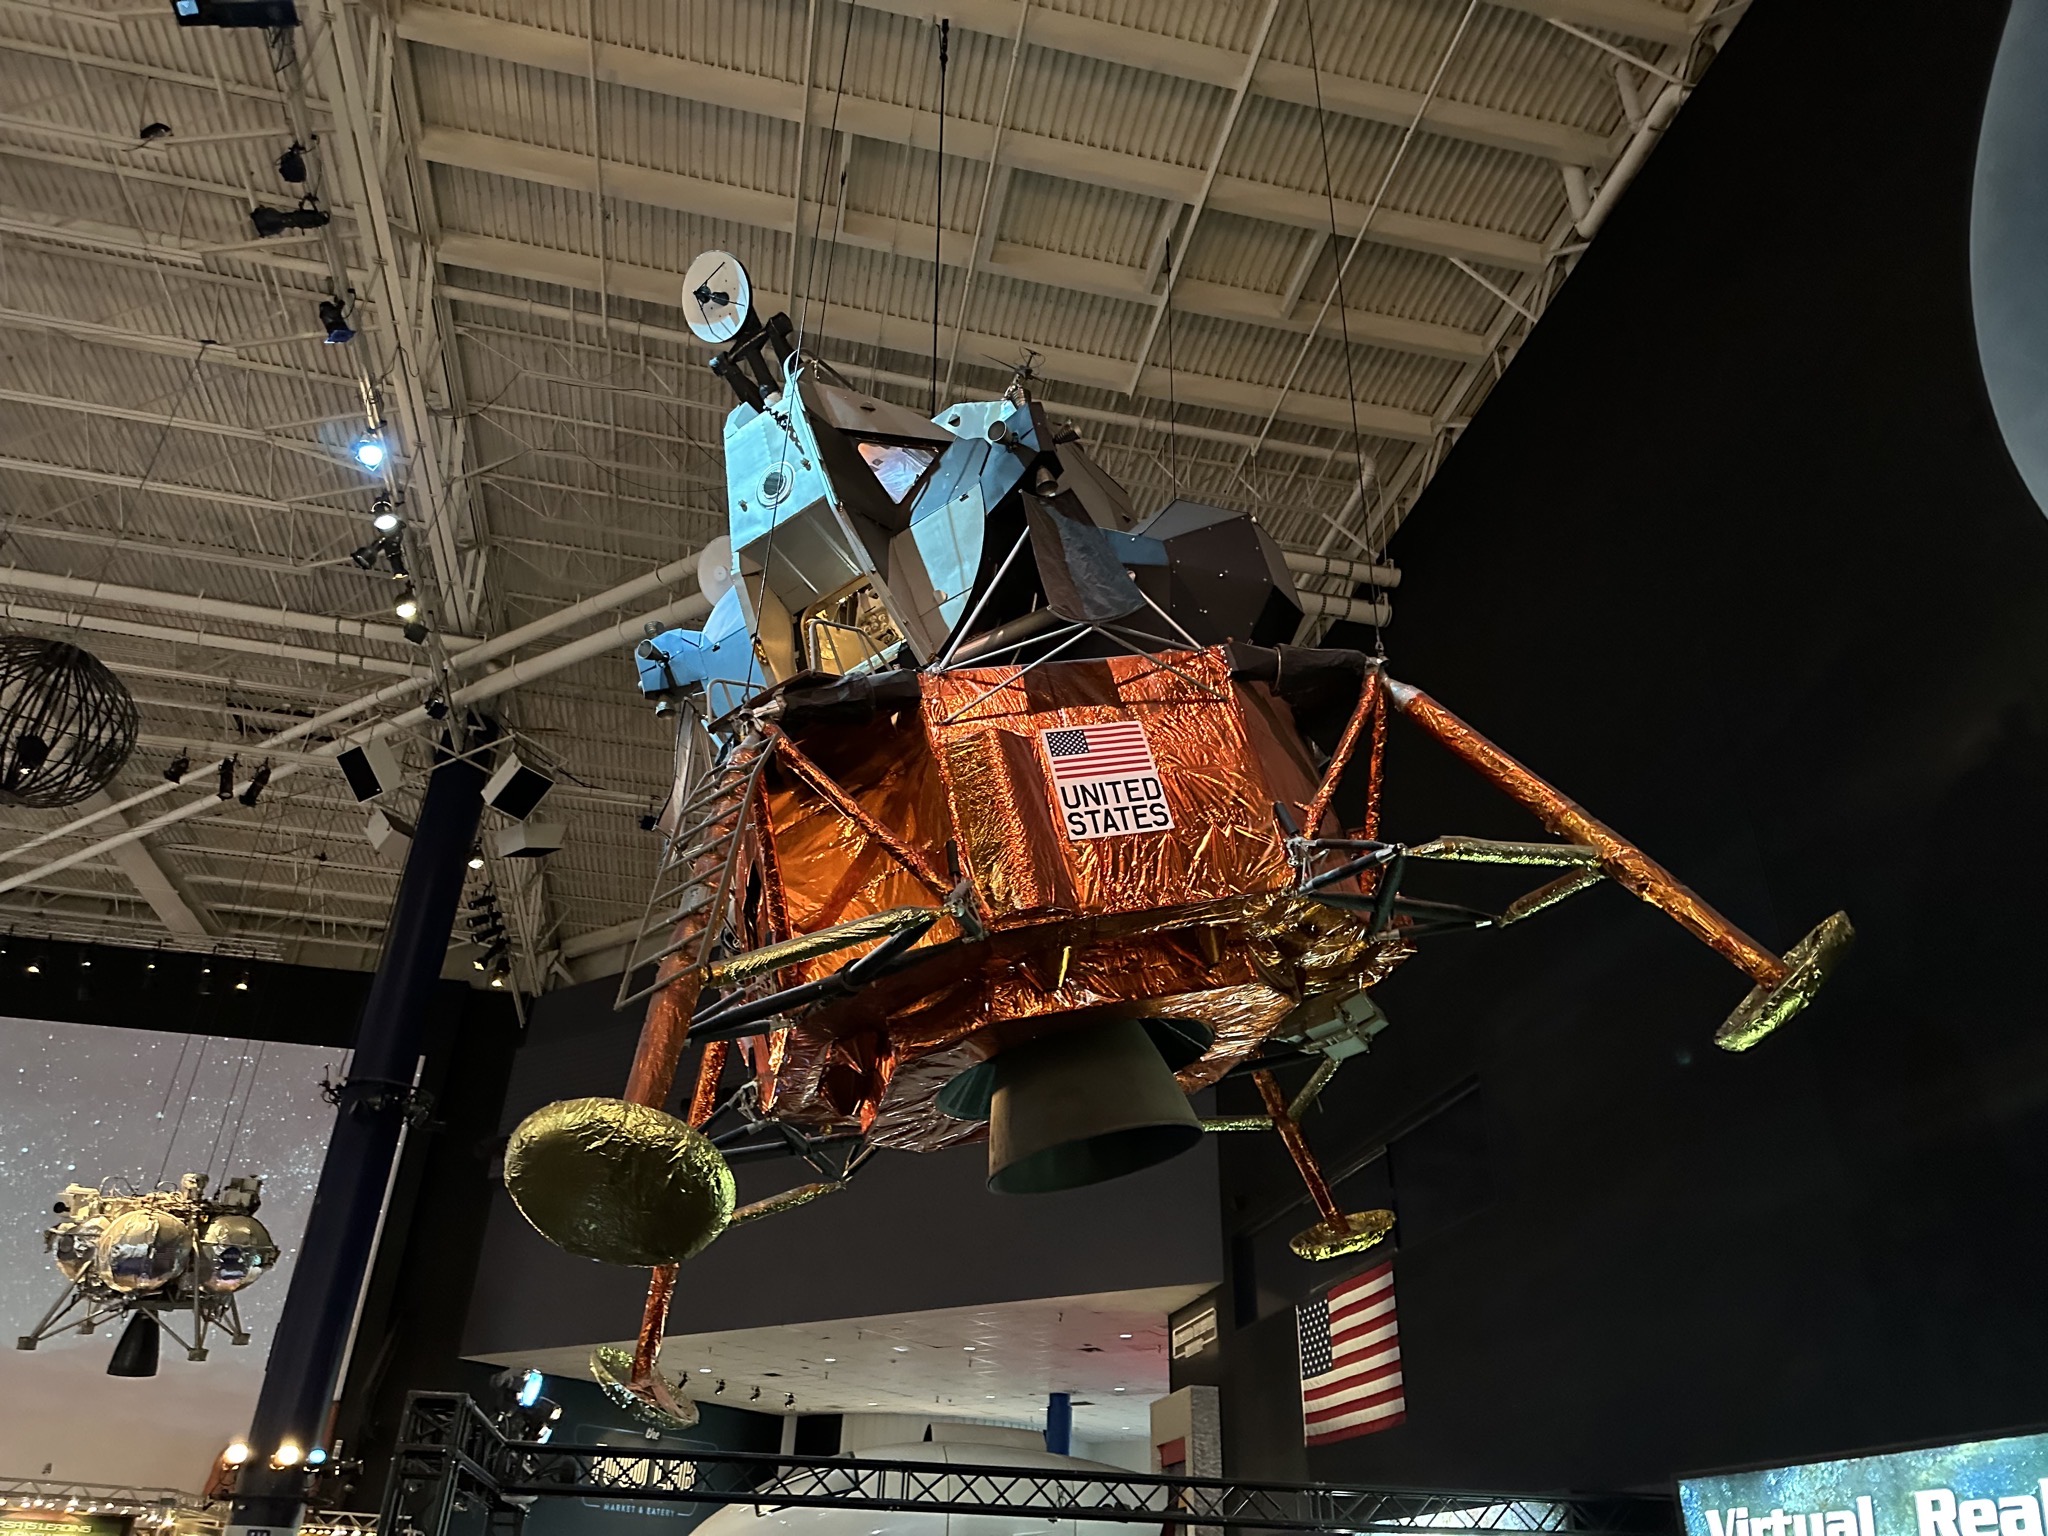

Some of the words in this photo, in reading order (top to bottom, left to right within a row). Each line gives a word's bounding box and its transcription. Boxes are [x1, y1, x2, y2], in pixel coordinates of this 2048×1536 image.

[1060, 777, 1162, 809] UNITED
[1067, 803, 1170, 836] STATES
[645, 1427, 660, 1440] the
[603, 1503, 635, 1513] MARKET
[638, 1506, 644, 1514] &
[646, 1507, 675, 1517] EATERY
[1705, 1495, 1876, 1536] Virtual
